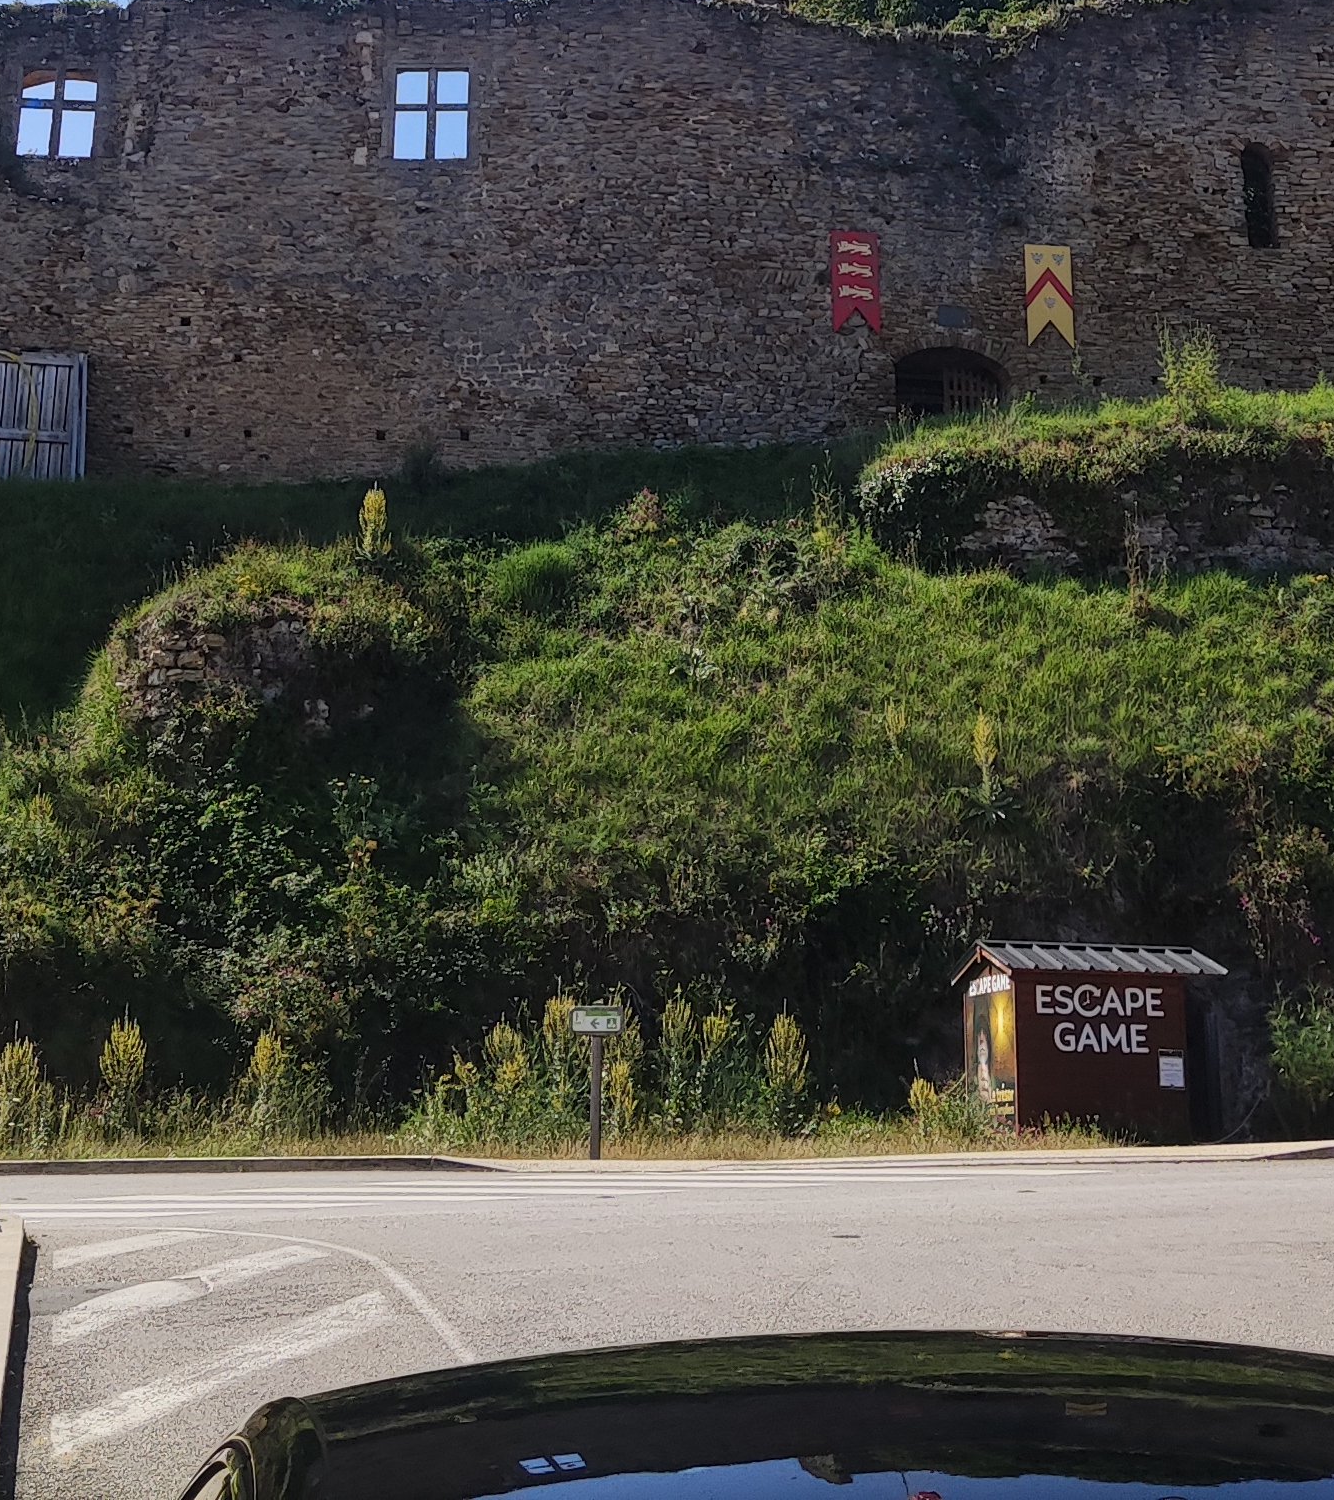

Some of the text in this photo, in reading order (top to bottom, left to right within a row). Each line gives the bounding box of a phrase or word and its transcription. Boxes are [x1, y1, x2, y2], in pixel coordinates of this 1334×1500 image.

[969, 973, 1011, 997] ESCAPE GAME
[1036, 984, 1164, 1017] ESCAPE
[1053, 1022, 1150, 1054] GAME
